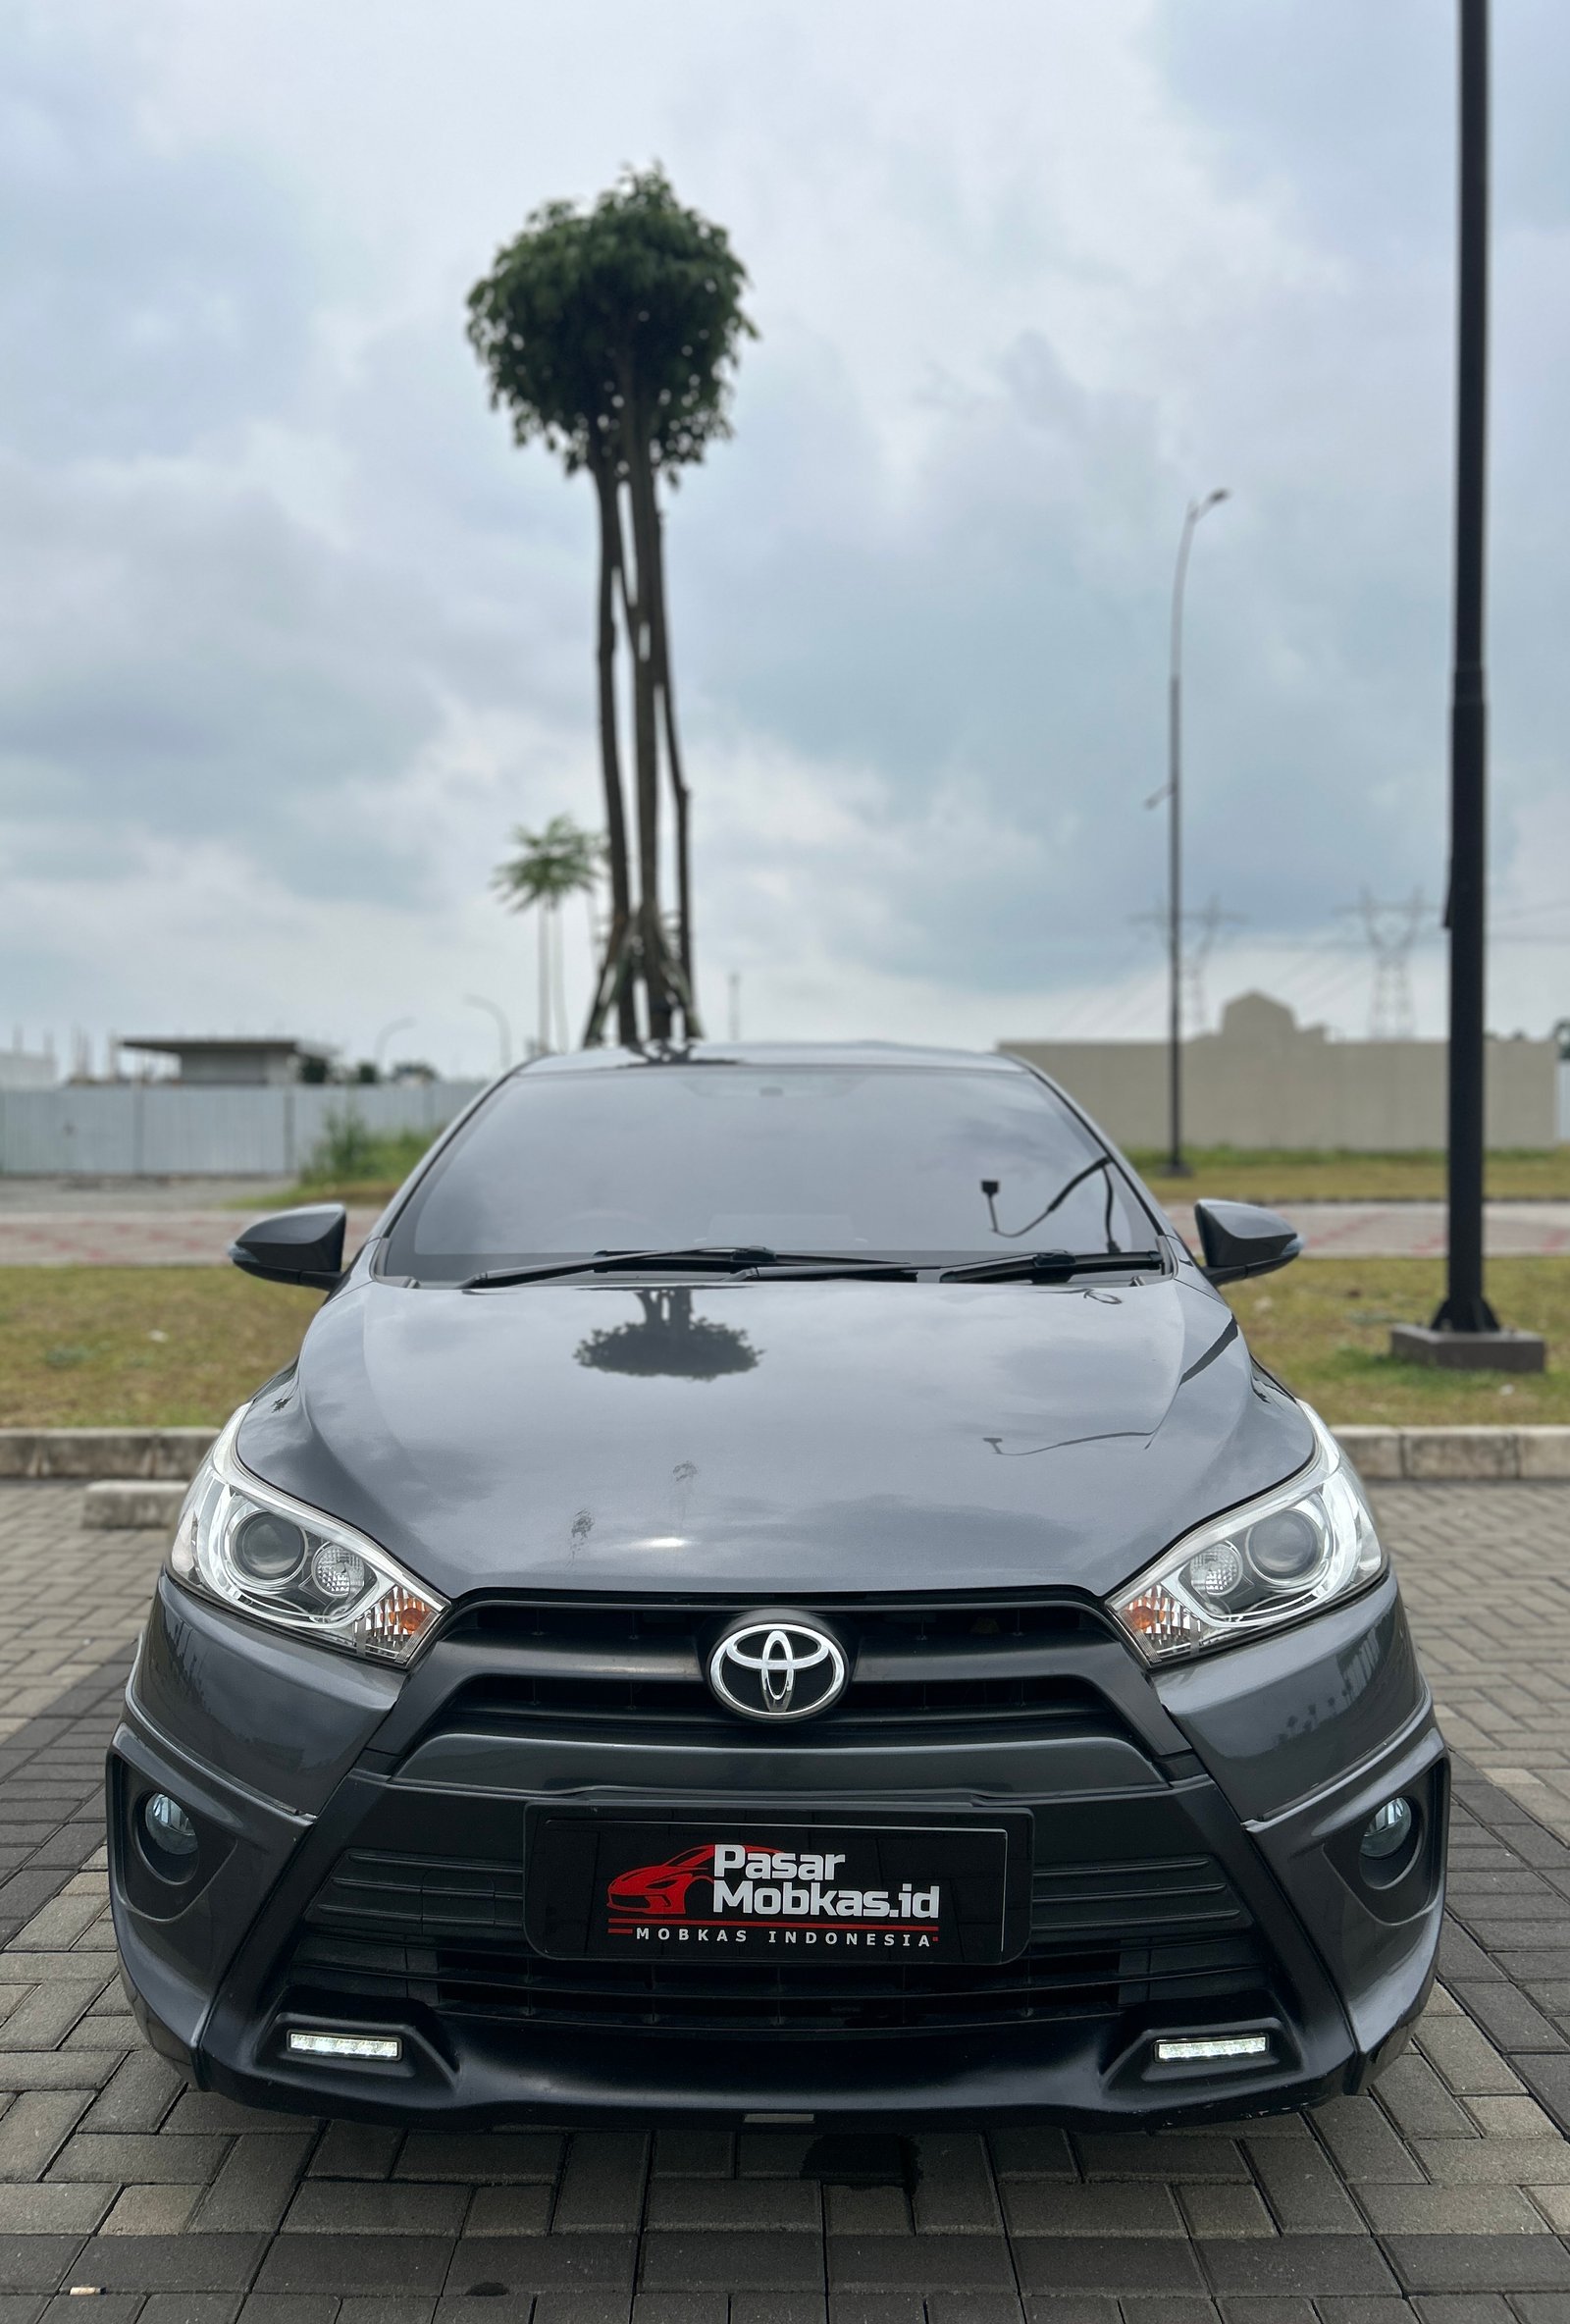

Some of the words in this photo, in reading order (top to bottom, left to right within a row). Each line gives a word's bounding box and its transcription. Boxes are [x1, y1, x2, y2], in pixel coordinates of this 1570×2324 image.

[713, 1844, 846, 1880] Pasar
[712, 1880, 939, 1919] Mobkas.id
[636, 1927, 748, 1943] MOBKAS
[768, 1930, 930, 1947] INDONESIA
